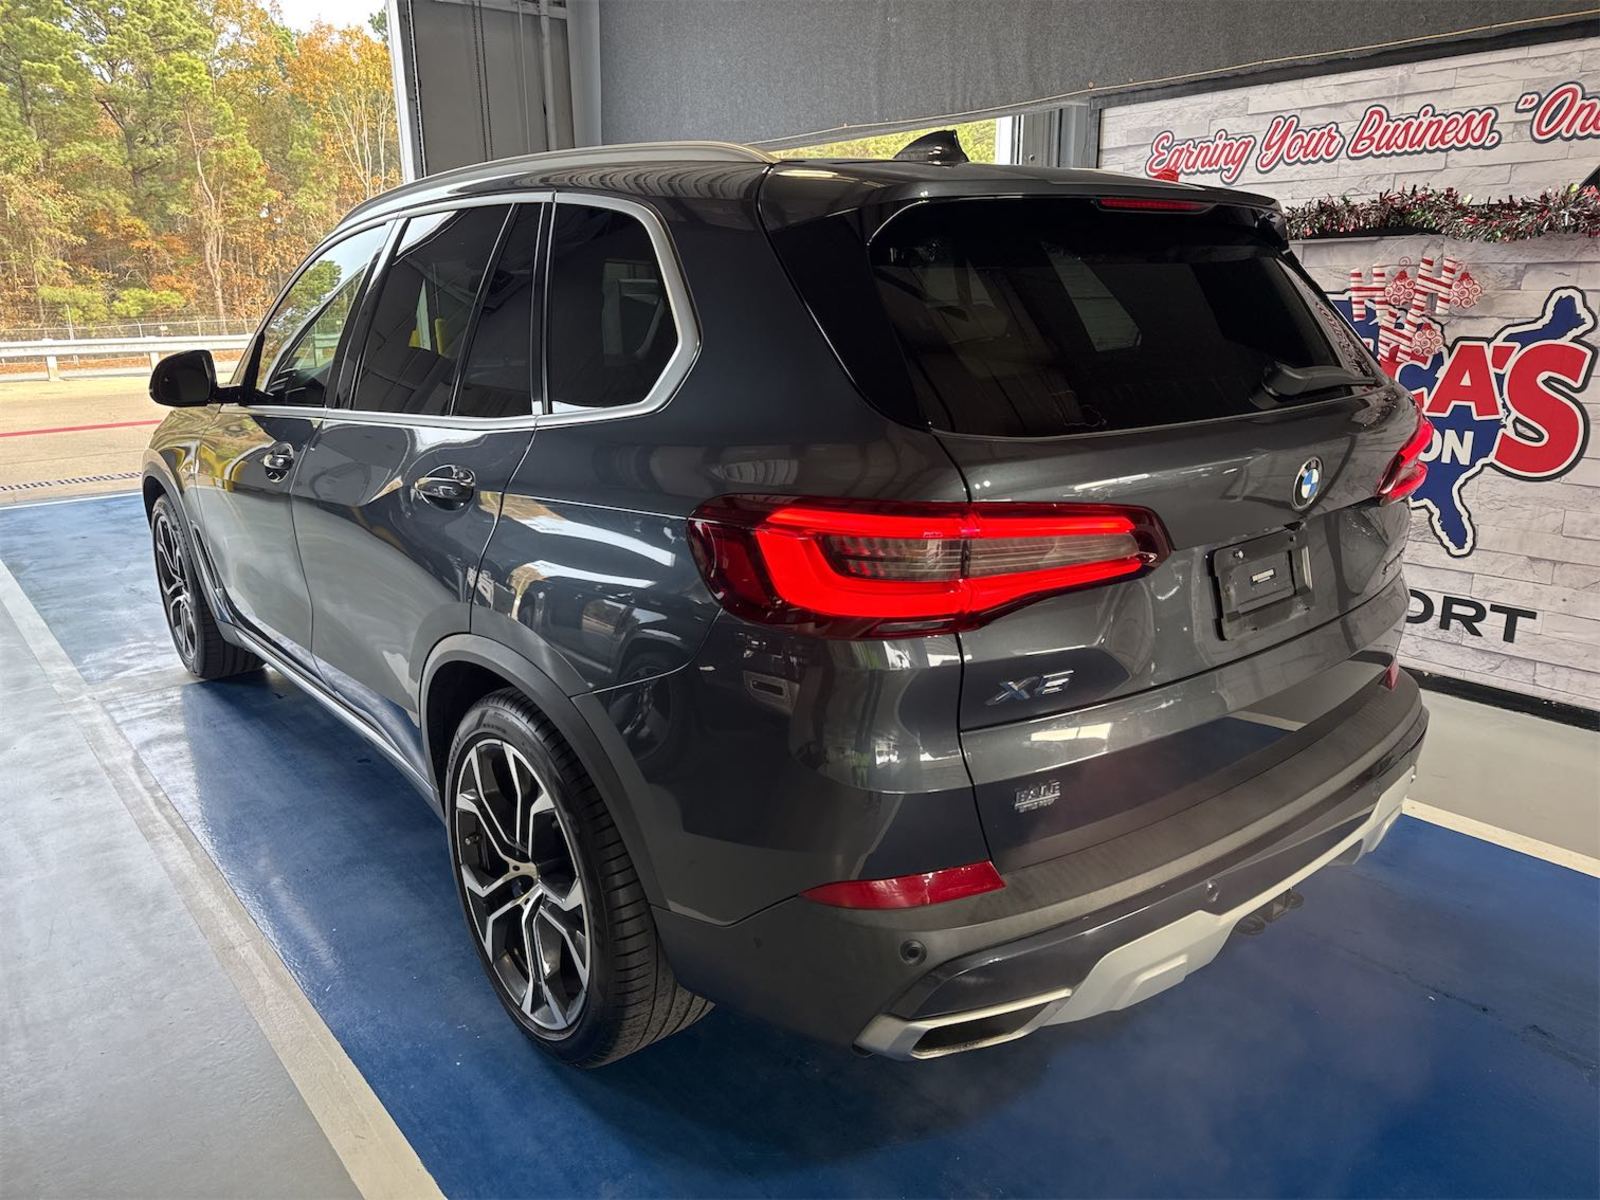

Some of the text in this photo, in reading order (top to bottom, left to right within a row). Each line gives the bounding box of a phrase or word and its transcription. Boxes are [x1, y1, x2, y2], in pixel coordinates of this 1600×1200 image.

[1147, 131, 1255, 183] Earning
[1258, 117, 1343, 172] Your
[1348, 105, 1501, 158] Business,
[985, 669, 1075, 706] X5
